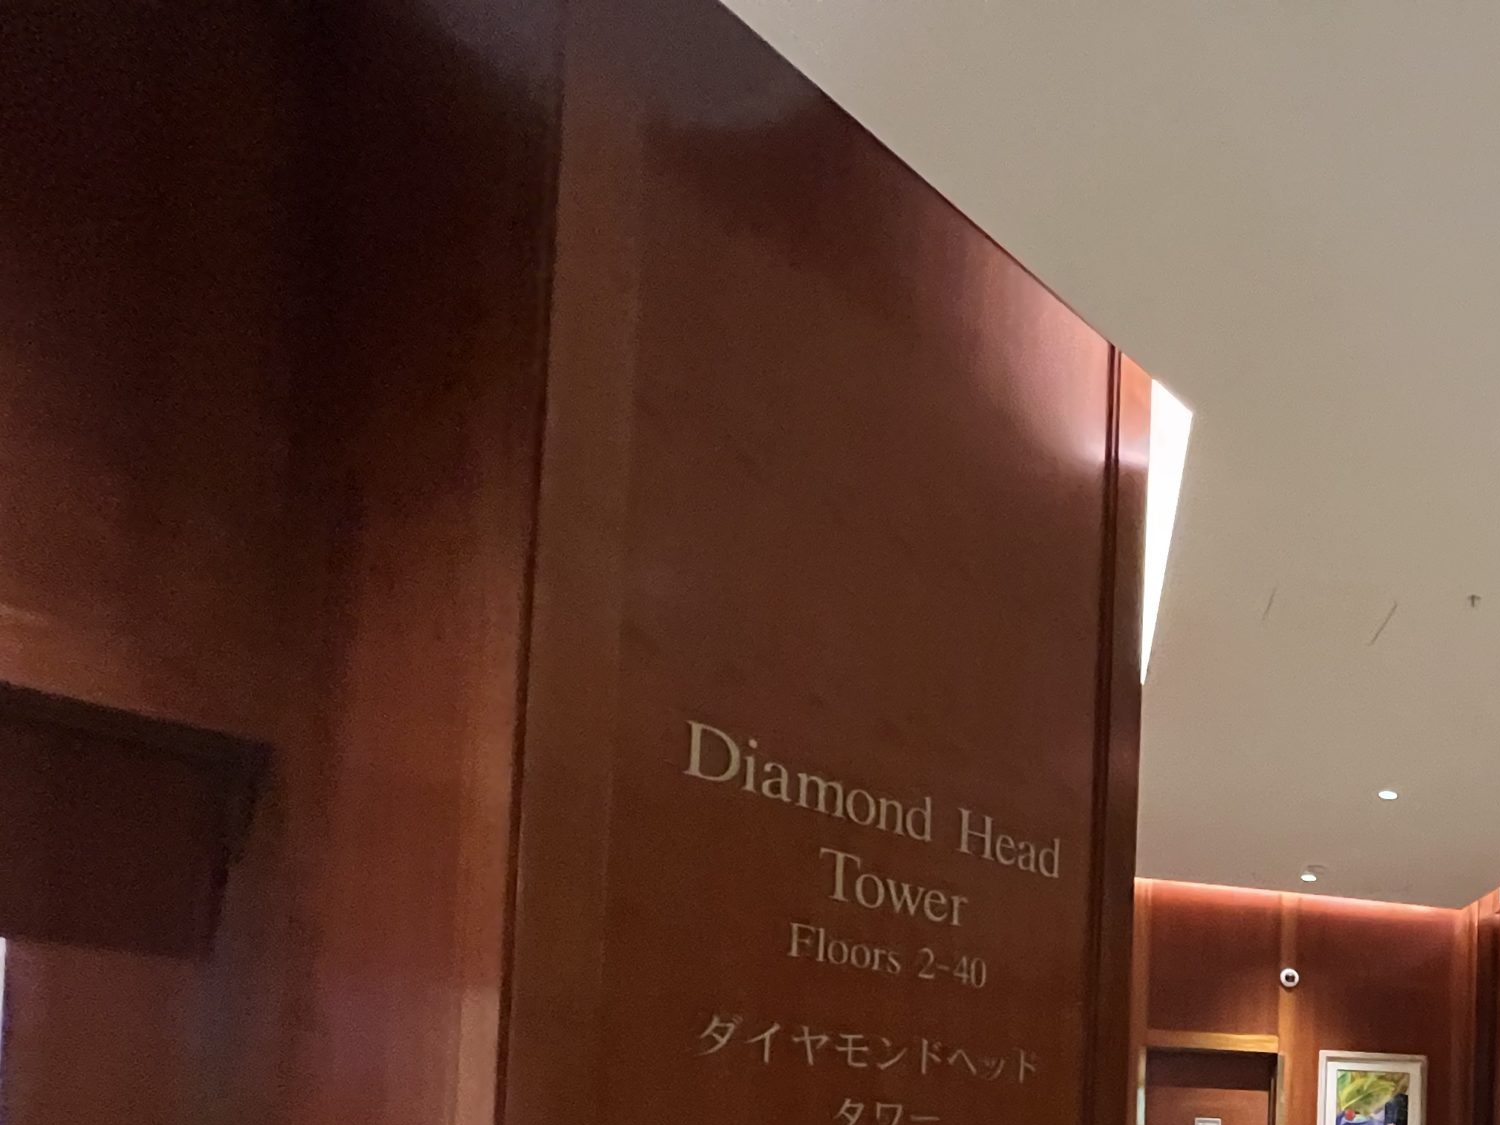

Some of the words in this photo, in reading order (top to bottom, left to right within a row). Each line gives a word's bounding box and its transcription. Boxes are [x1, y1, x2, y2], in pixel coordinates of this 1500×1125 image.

[683, 720, 932, 842] Diamond
[957, 808, 1060, 879] Head
[819, 847, 968, 926] Tower
[787, 922, 902, 974] Floors
[917, 947, 988, 989] 2-40
[694, 1013, 1038, 1084] ダイヤモンドヘッド
